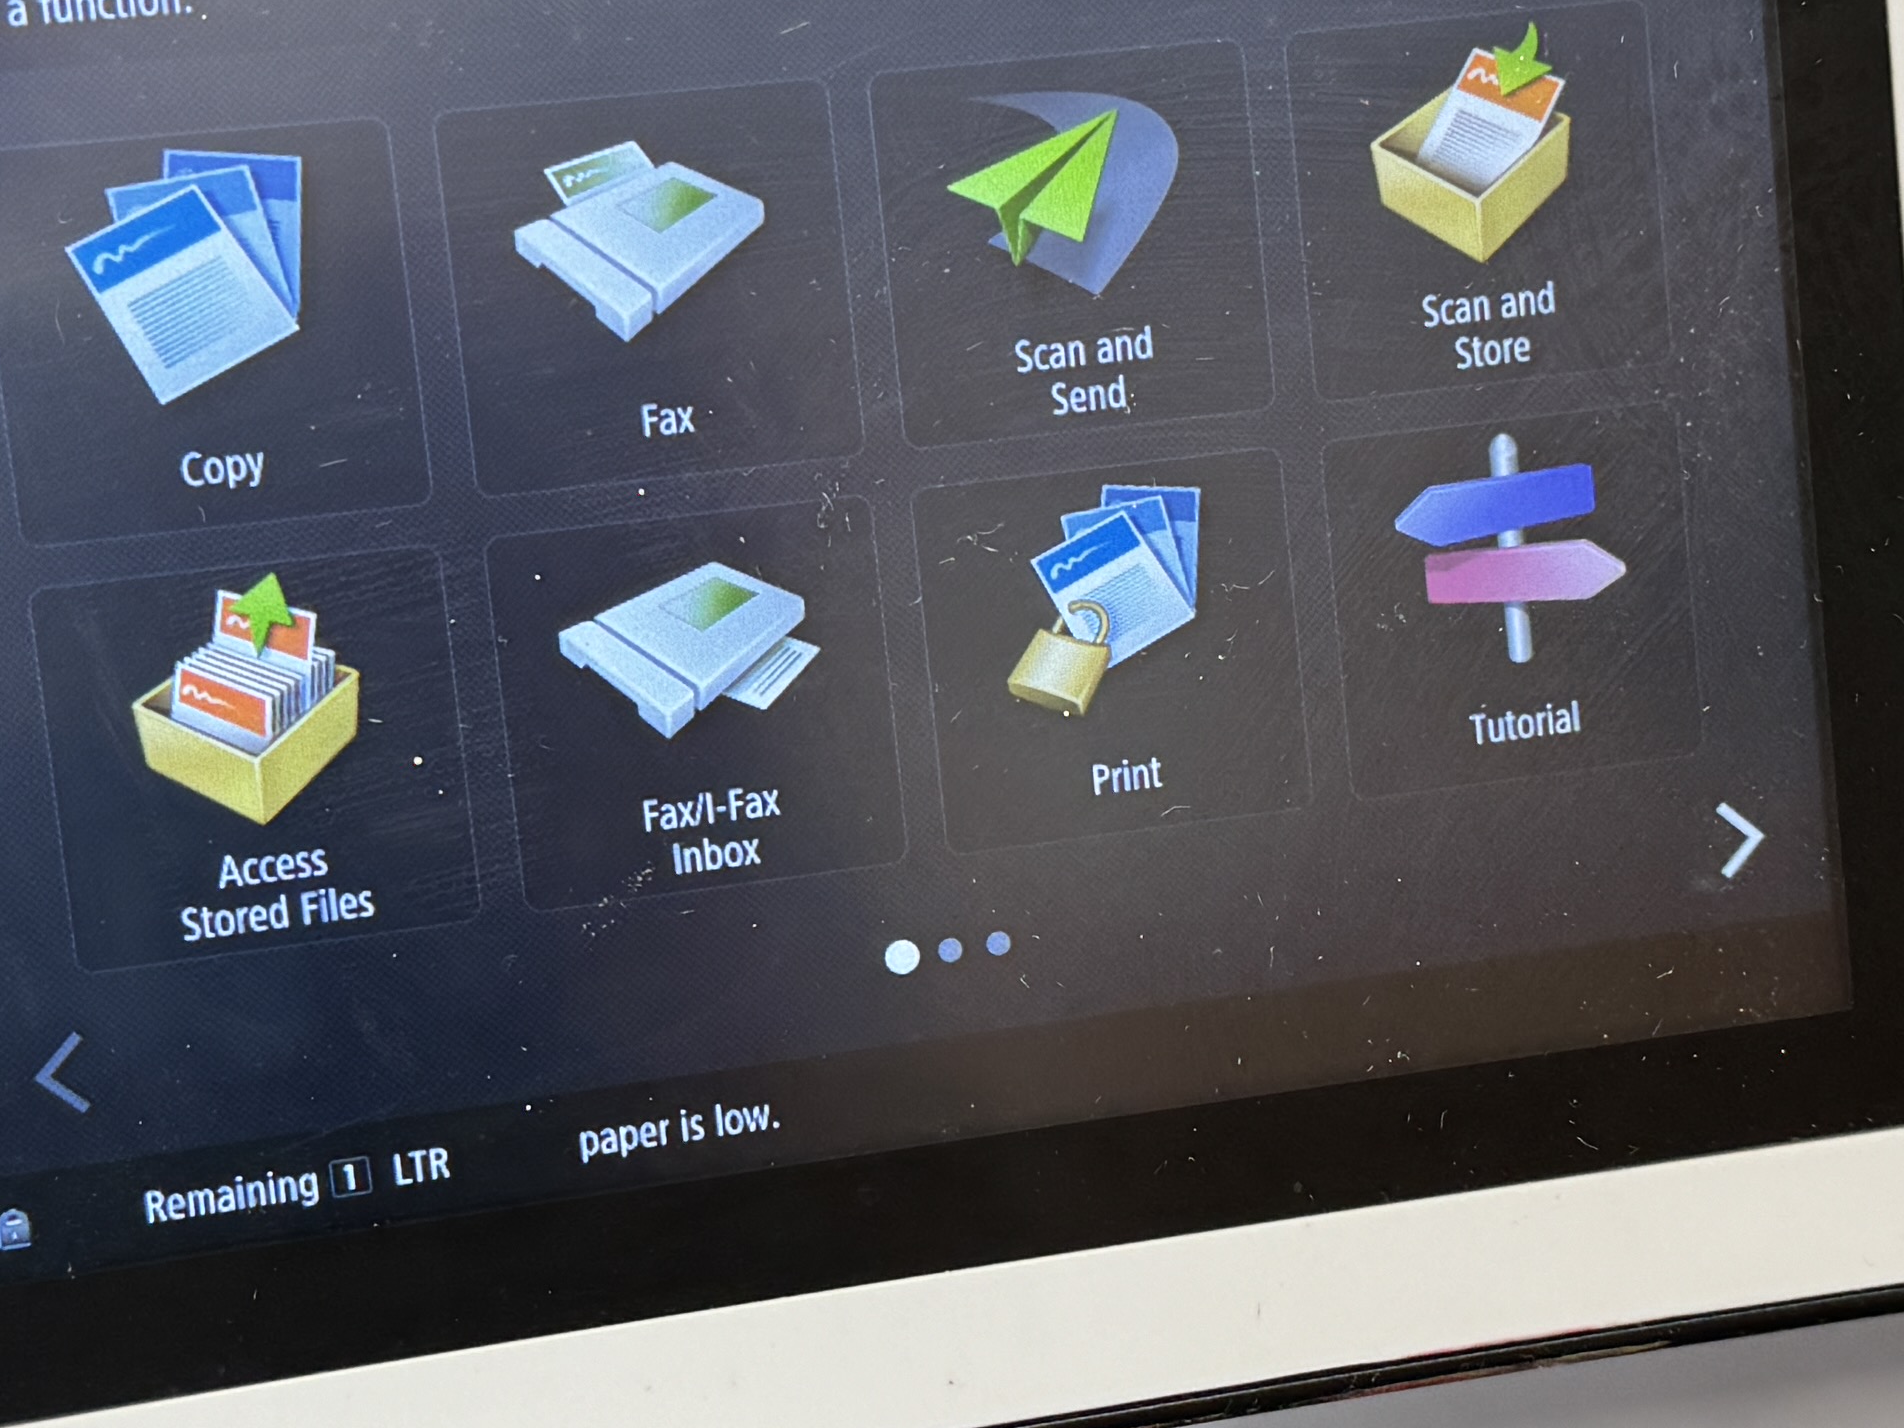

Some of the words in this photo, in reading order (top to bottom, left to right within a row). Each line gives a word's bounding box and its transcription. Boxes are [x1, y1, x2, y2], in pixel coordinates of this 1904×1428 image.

[1422, 291, 1492, 328] Scan
[1500, 281, 1557, 319] and
[1014, 335, 1087, 374] Scan
[1097, 325, 1155, 363] and
[1454, 333, 1532, 371] Store
[1050, 375, 1128, 416] Send
[641, 402, 696, 439] Fax
[180, 449, 265, 490] Copy
[1469, 701, 1581, 747] Tutorial
[1092, 756, 1164, 796] Print
[641, 786, 781, 834] Fax/I-Fax
[218, 846, 328, 891] Access
[672, 836, 762, 877] Inbox
[180, 895, 290, 944] Stored
[299, 886, 376, 926] Files
[144, 1164, 321, 1226] Remaining
[393, 1147, 452, 1188] LTR
[579, 1117, 670, 1165] paper
[680, 1107, 707, 1144] is
[714, 1099, 782, 1138] low.
